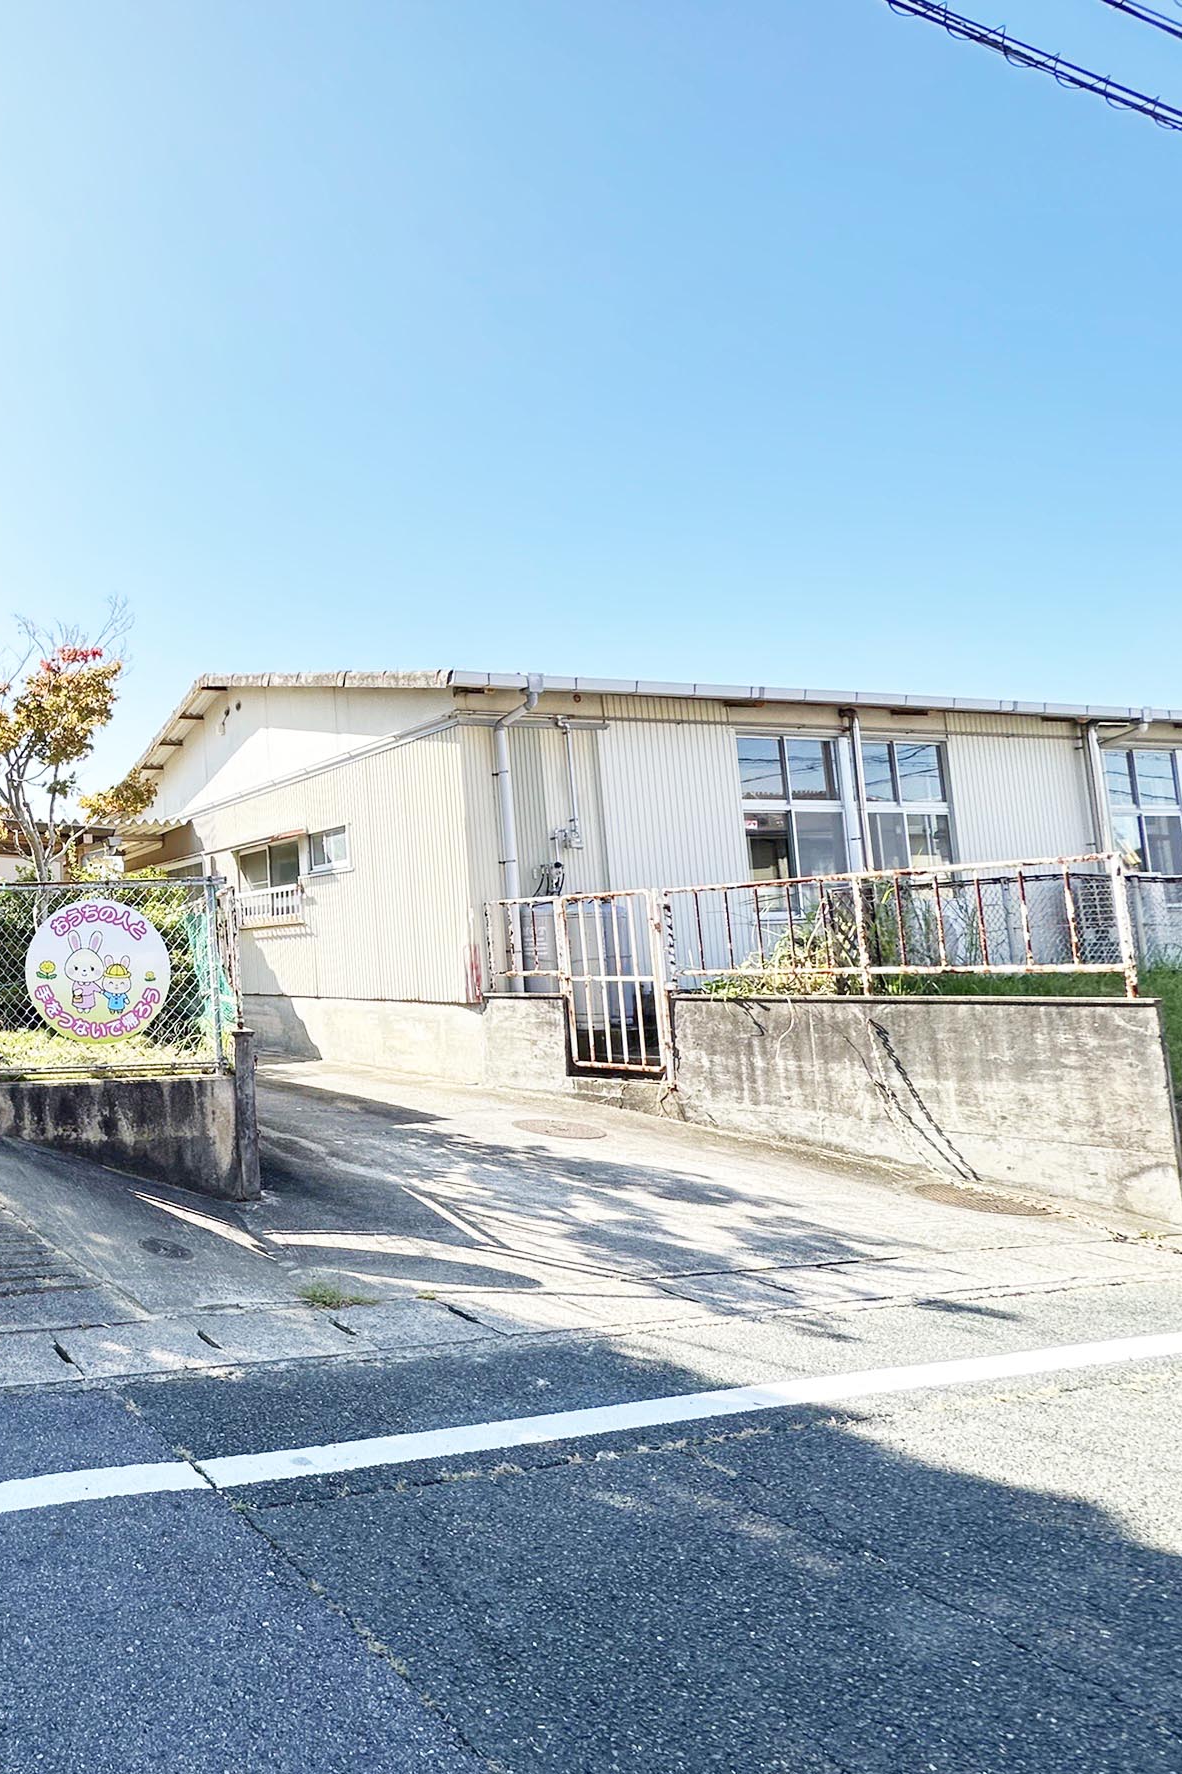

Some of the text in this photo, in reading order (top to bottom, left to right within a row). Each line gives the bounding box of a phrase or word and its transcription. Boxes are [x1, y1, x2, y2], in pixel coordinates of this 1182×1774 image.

[50, 904, 148, 941] おうちの人と
[35, 984, 161, 1039] 手をつないで帰ろう
